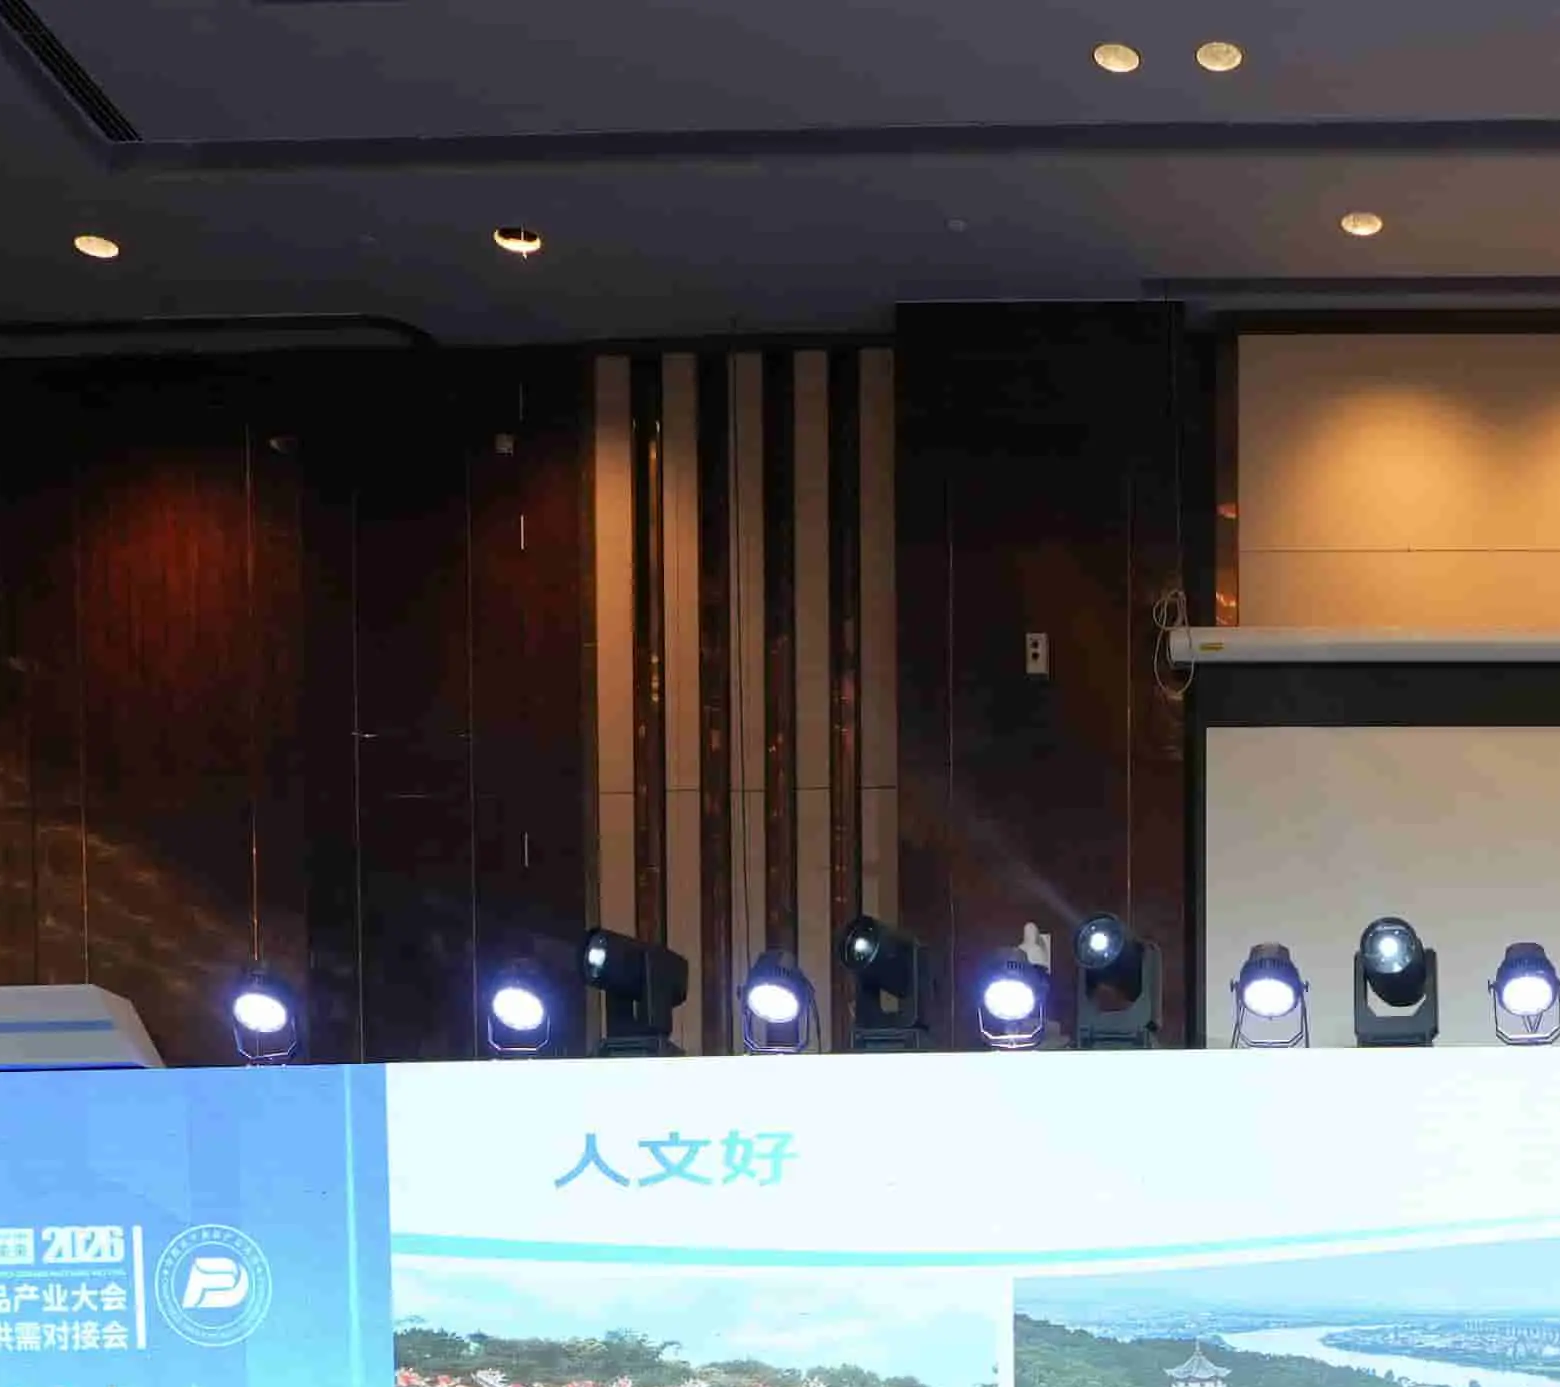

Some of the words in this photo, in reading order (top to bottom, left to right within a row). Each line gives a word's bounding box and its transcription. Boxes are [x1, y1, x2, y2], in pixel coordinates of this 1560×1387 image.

[553, 1129, 801, 1189] 人文好
[41, 1225, 125, 1264] 2026
